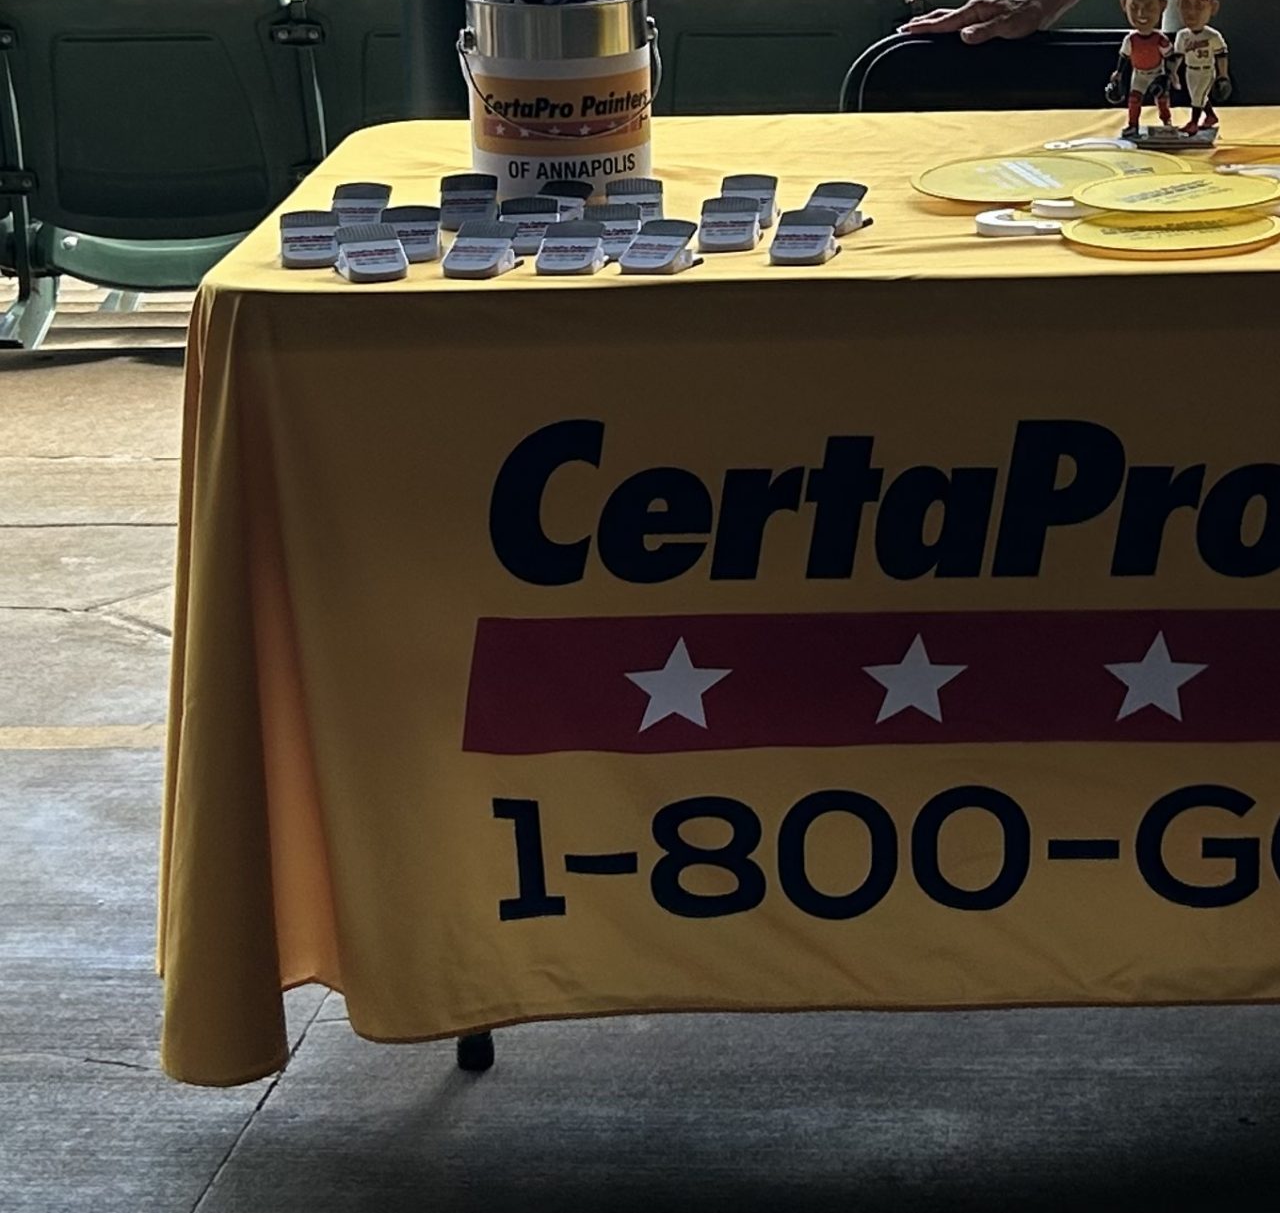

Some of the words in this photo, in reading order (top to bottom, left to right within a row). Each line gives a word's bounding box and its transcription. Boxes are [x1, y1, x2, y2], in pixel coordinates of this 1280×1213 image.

[484, 93, 574, 119] CertaPro
[508, 160, 530, 179] OF
[536, 153, 636, 181] ANNAPOLIS
